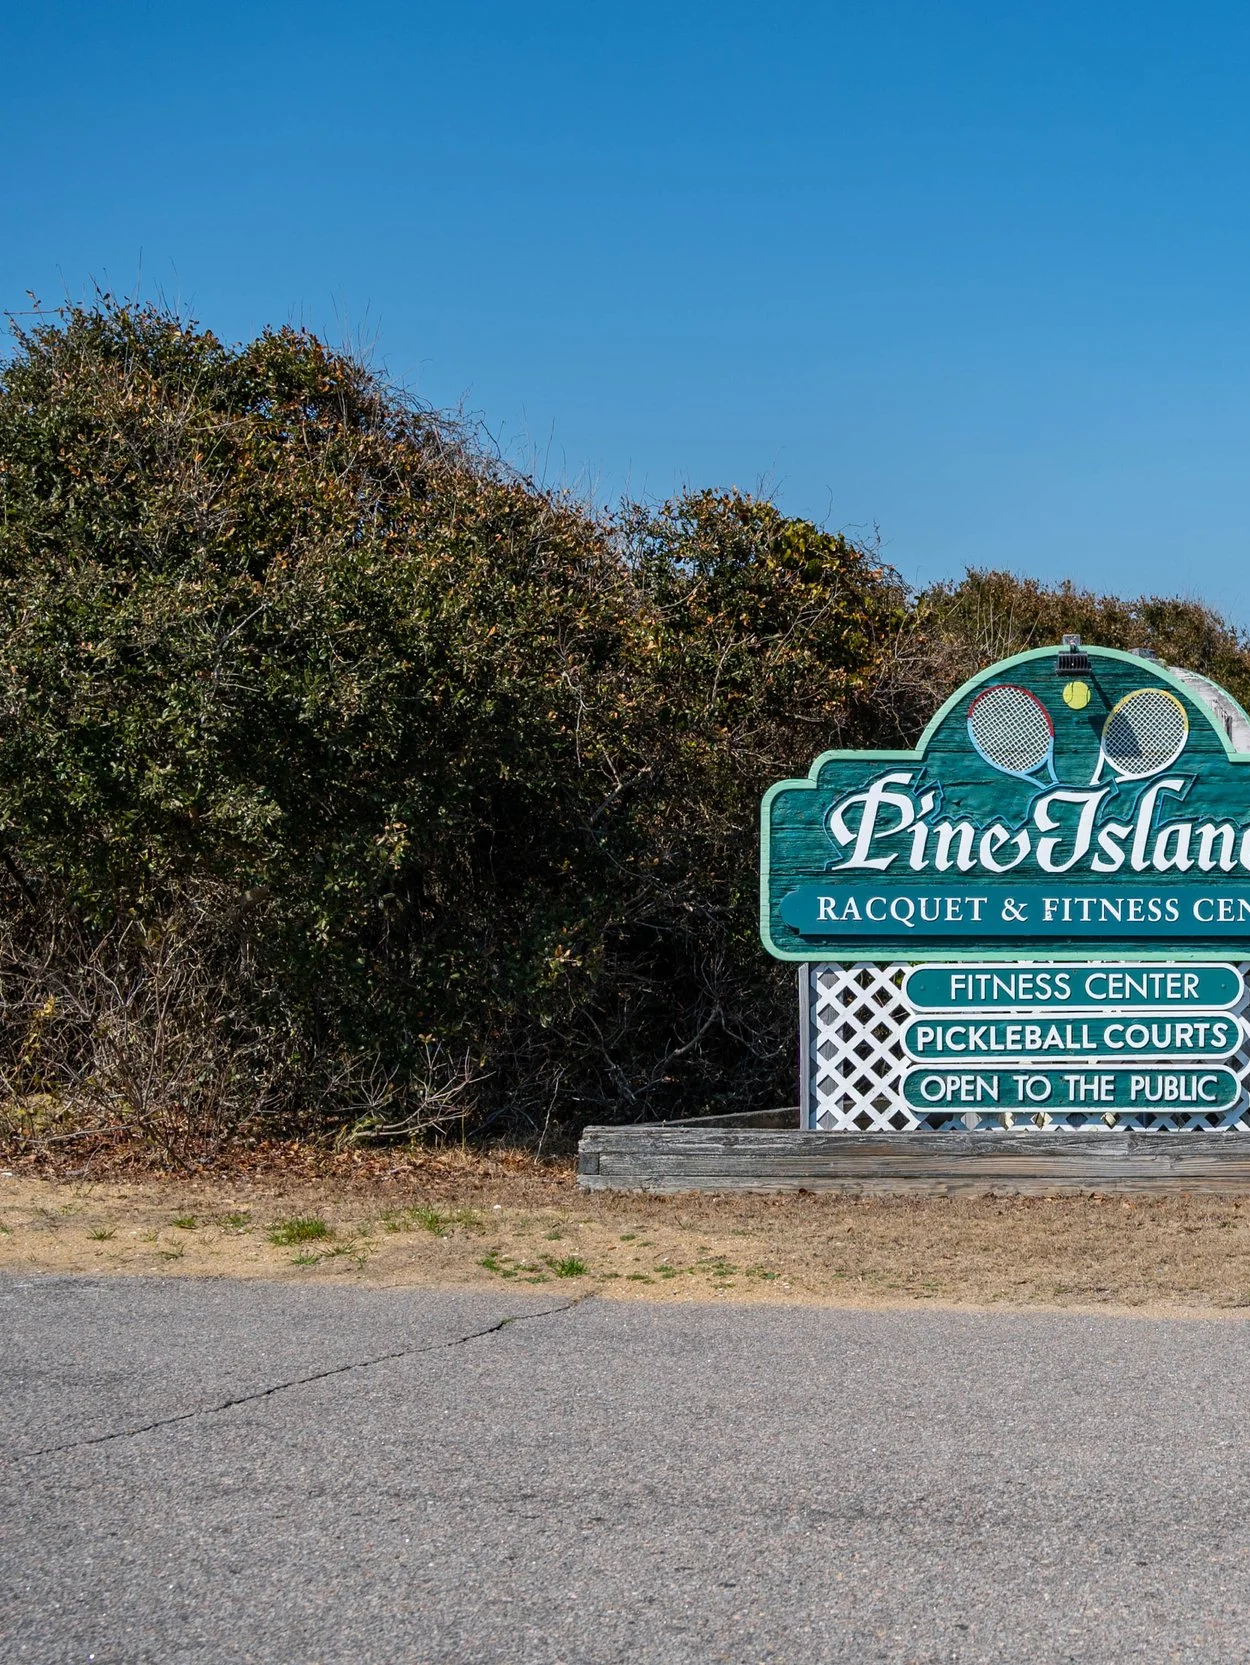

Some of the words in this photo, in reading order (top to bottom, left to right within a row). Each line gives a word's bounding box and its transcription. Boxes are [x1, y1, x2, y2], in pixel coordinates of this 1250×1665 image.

[831, 772, 1031, 873] Pine
[816, 896, 988, 928] RACQUET
[1001, 897, 1028, 922] &
[1042, 898, 1180, 922] FITNESS
[950, 973, 1071, 1000] FITNESS
[1084, 973, 1199, 999] CENTER
[916, 1024, 1097, 1052] PICKLEBALL
[1103, 1022, 1228, 1049] COURTS
[920, 1075, 998, 1101] OPEN
[1012, 1075, 1052, 1101] TO
[1063, 1075, 1115, 1101] THE
[1129, 1075, 1218, 1101] PUBLIC
